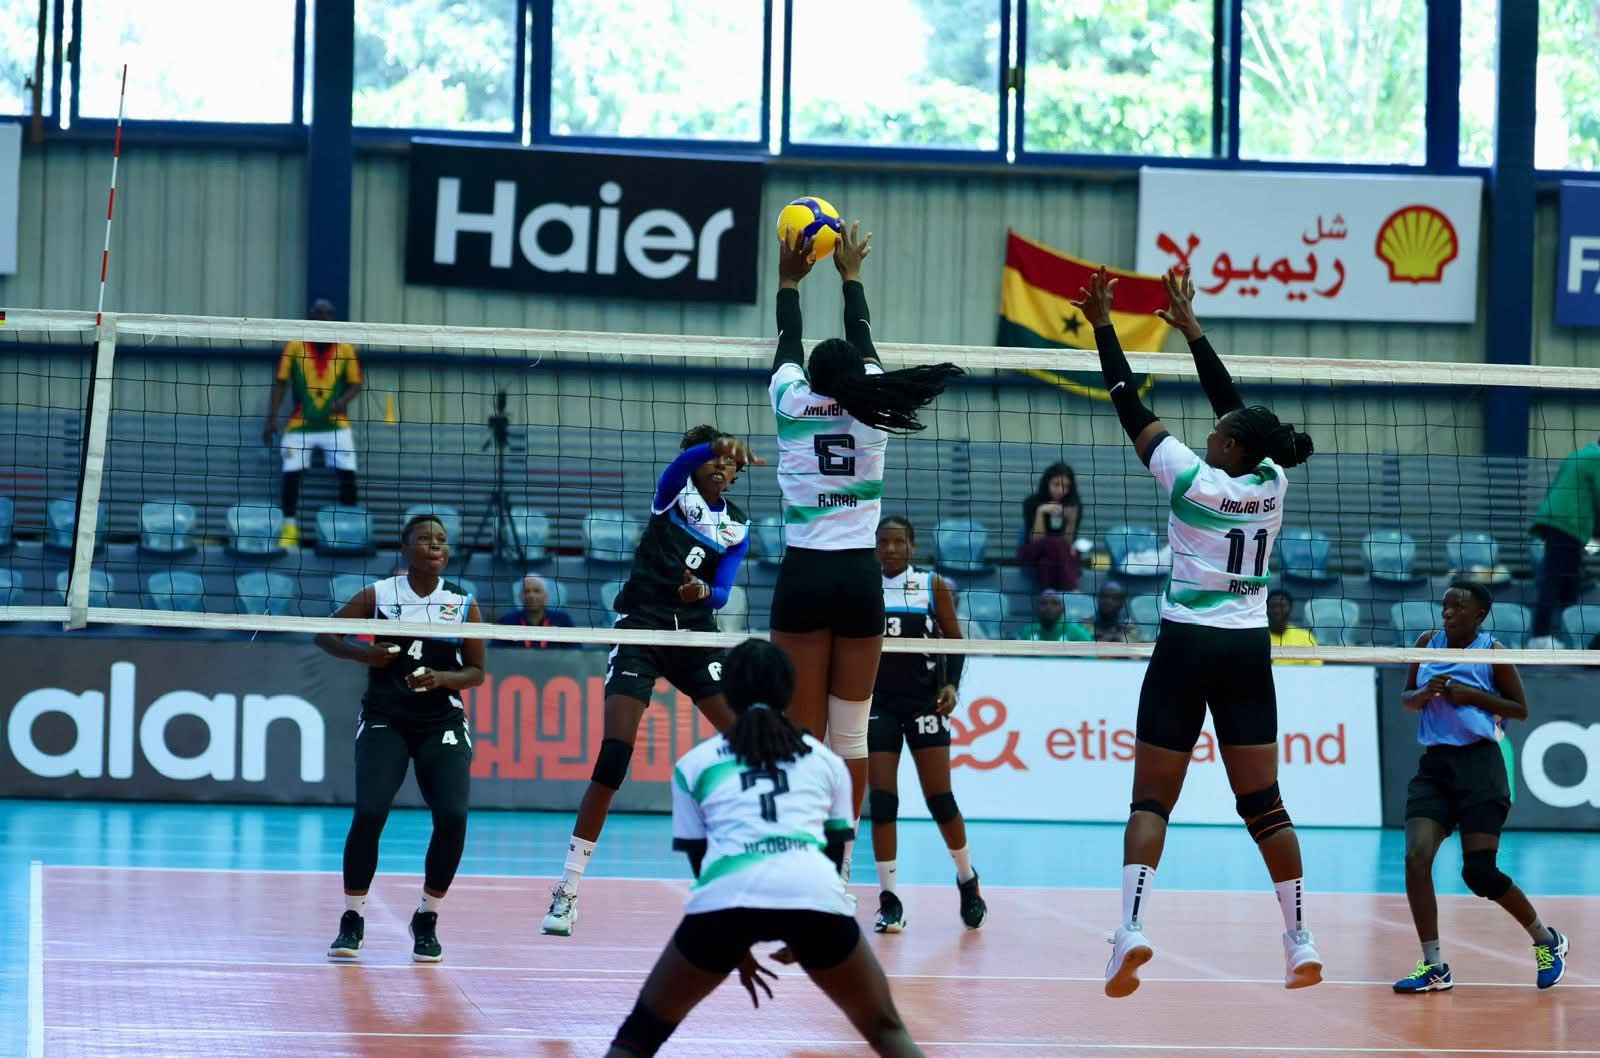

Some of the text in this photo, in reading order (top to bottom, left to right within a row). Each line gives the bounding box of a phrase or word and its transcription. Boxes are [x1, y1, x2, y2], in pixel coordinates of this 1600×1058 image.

[434, 177, 734, 281] Haier
[1302, 213, 1348, 246] شل
[1156, 232, 1346, 301] ريميولا
[1567, 236, 1600, 294] F
[813, 434, 856, 476] 6
[1220, 498, 1259, 514] HALIBI
[685, 546, 705, 570] 6
[1224, 528, 1268, 576] 11
[883, 616, 902, 637] 3
[407, 639, 423, 660] 4
[7, 661, 325, 783] alan
[441, 730, 459, 745] 4
[915, 714, 939, 734] 13
[1277, 722, 1346, 765] nd
[740, 767, 790, 823] 7
